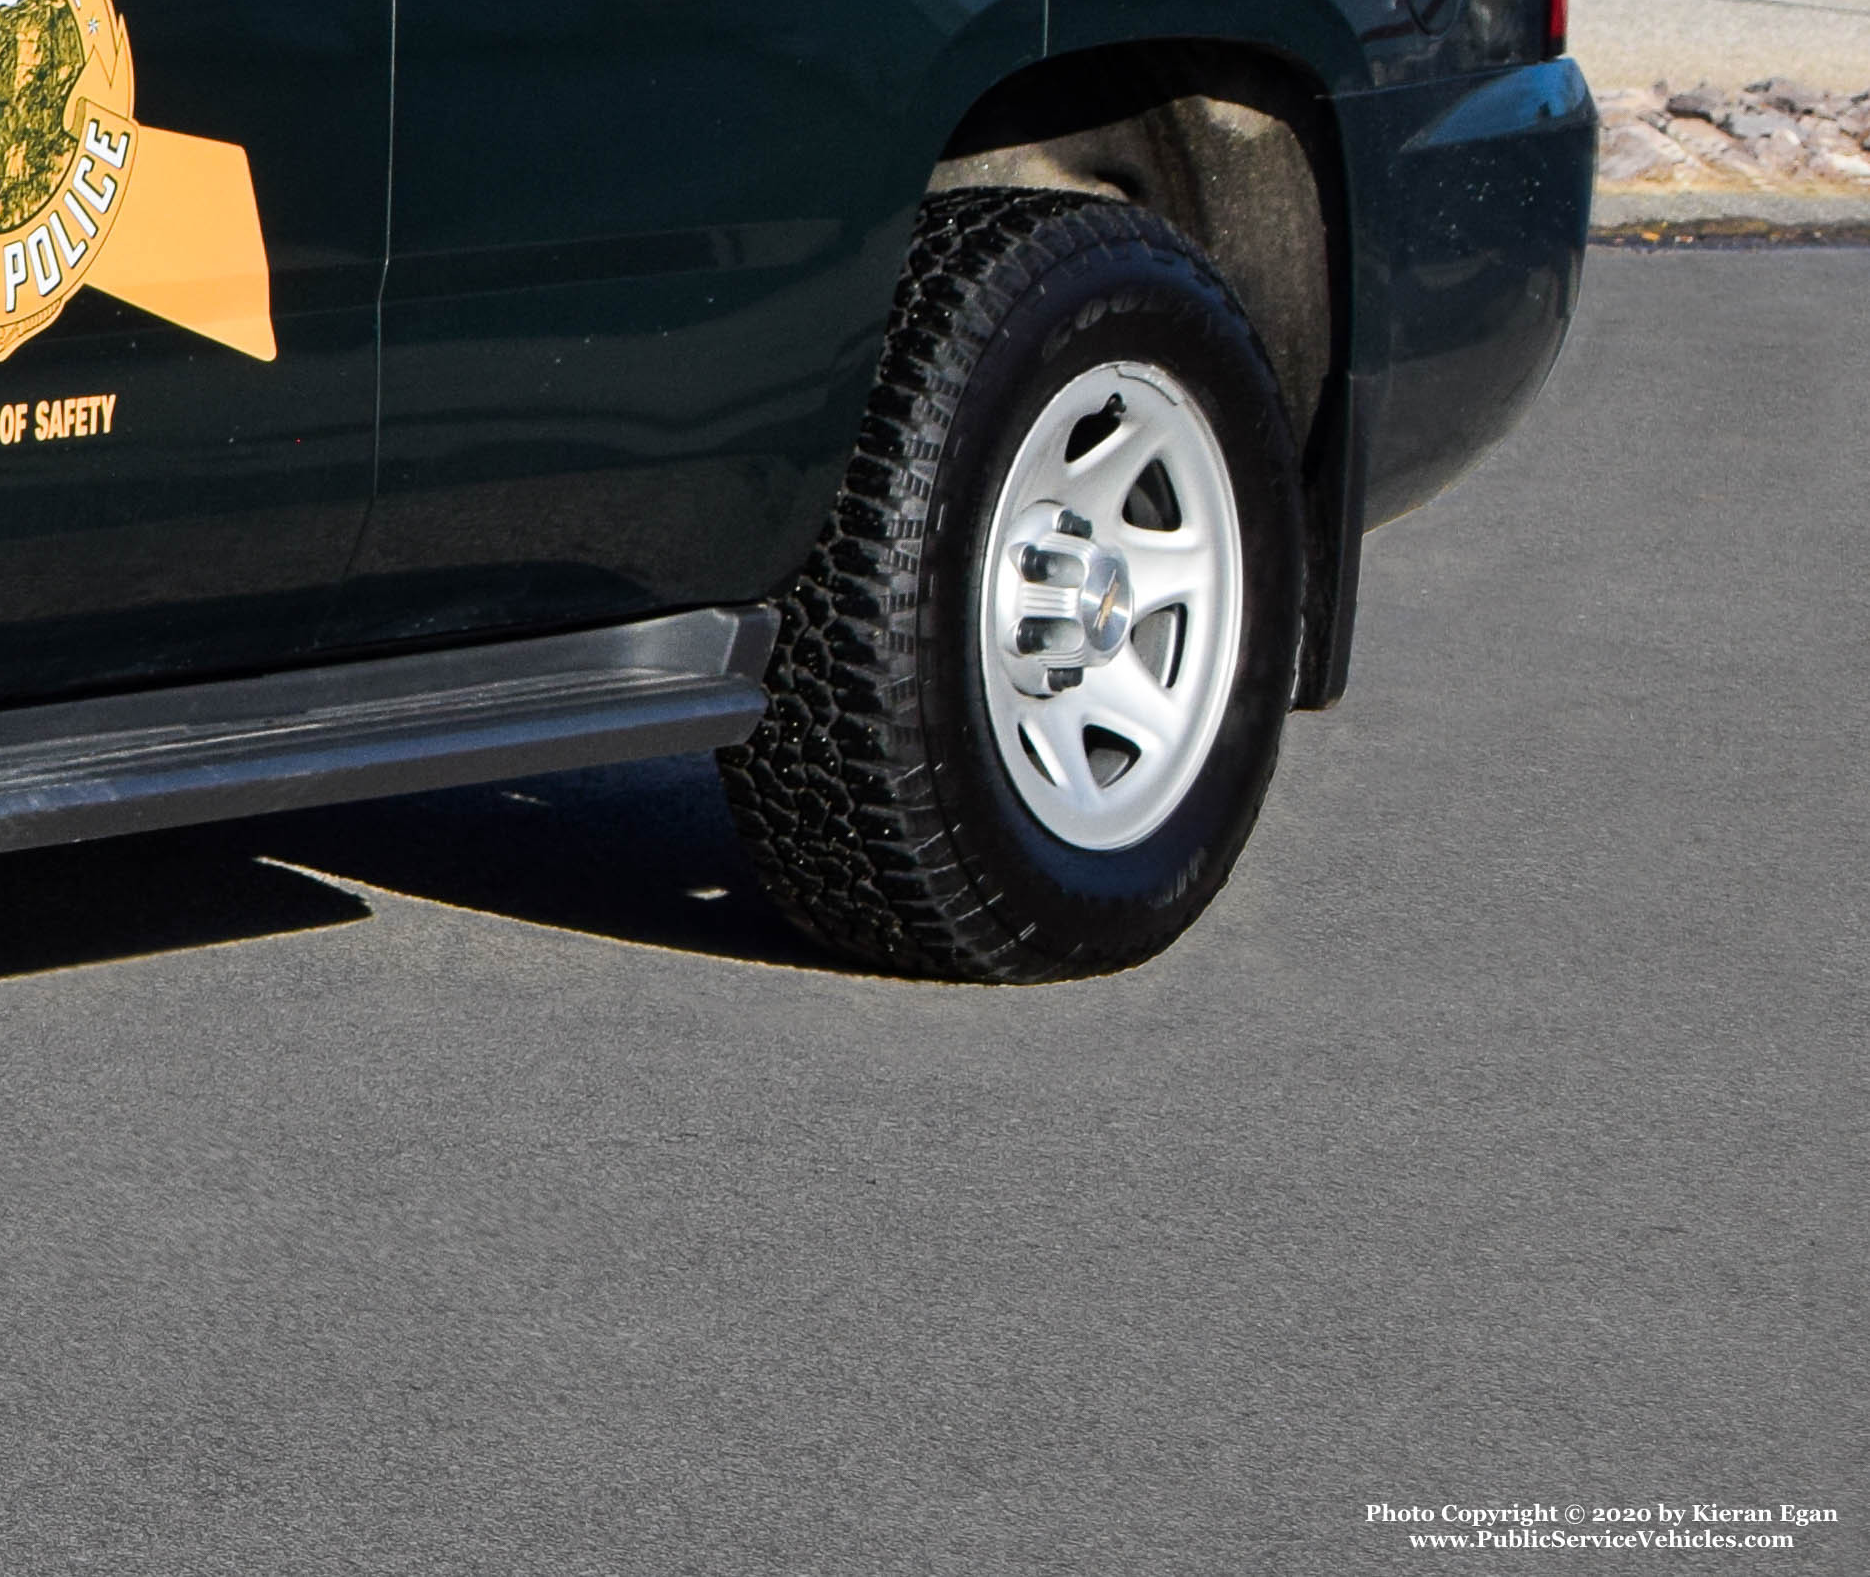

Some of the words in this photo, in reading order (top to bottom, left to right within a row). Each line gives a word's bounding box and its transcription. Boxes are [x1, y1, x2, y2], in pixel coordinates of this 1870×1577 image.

[3, 119, 132, 314] POLICE
[0, 403, 29, 445] OF
[34, 394, 117, 442] SAFETY
